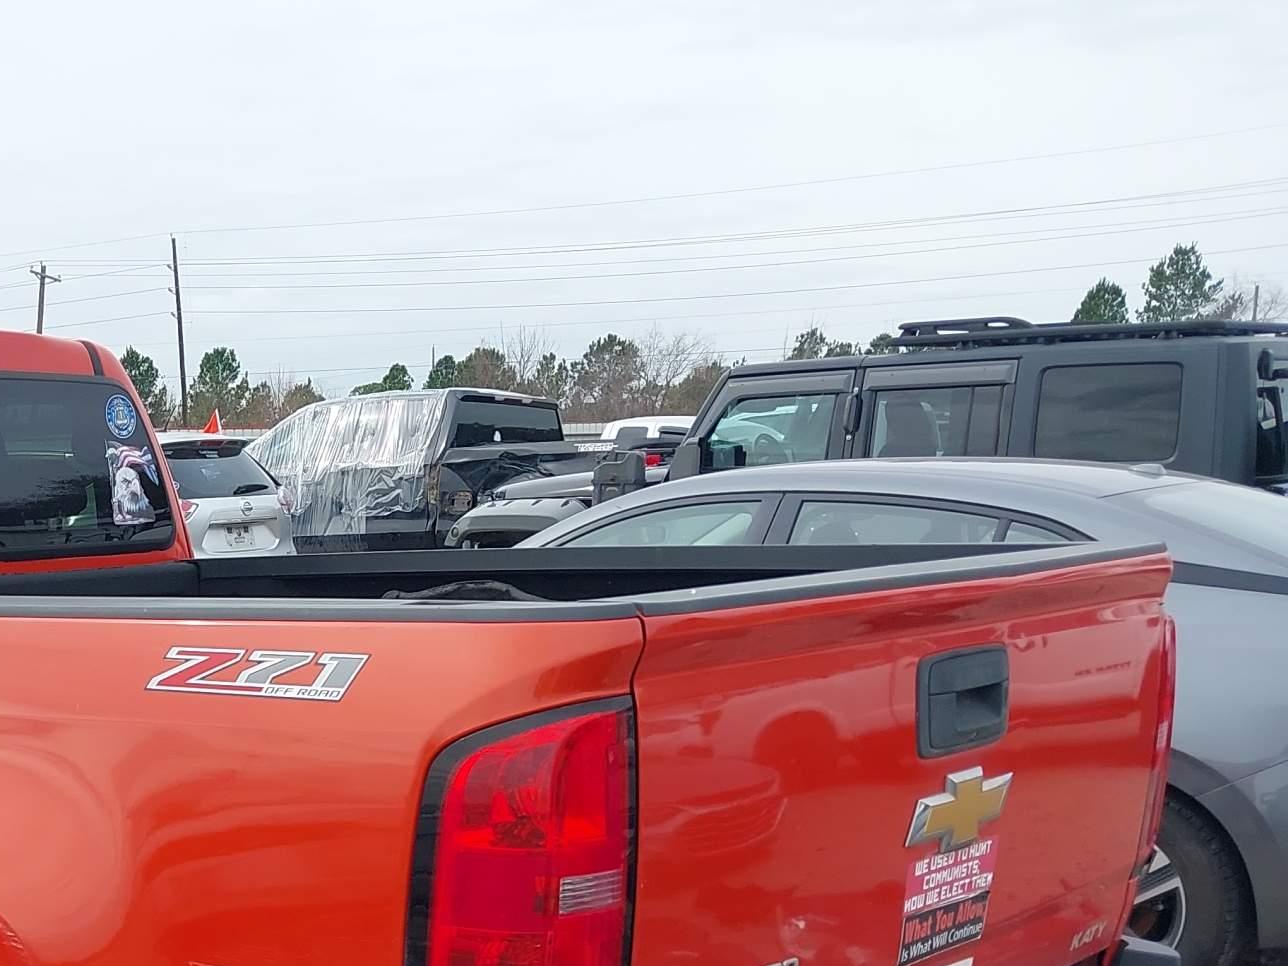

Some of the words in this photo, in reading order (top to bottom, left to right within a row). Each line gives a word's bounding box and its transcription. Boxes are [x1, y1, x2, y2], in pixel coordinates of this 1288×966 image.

[144, 645, 372, 701] Z71
[263, 685, 295, 697] OFF
[295, 687, 342, 699] ROAD
[914, 858, 929, 876] WE
[930, 851, 956, 871] USED
[957, 848, 969, 863] TO
[968, 840, 993, 859] HUNT
[904, 893, 926, 913] NOW
[926, 886, 940, 906] WE
[940, 878, 970, 900] ELECT
[905, 916, 932, 944] What
[935, 908, 956, 932] You
[955, 899, 987, 925] Allow
[1069, 919, 1107, 951] KATY
[901, 946, 909, 963] Is
[909, 939, 932, 957] What
[932, 931, 948, 950] Will
[948, 921, 984, 943] Continue
